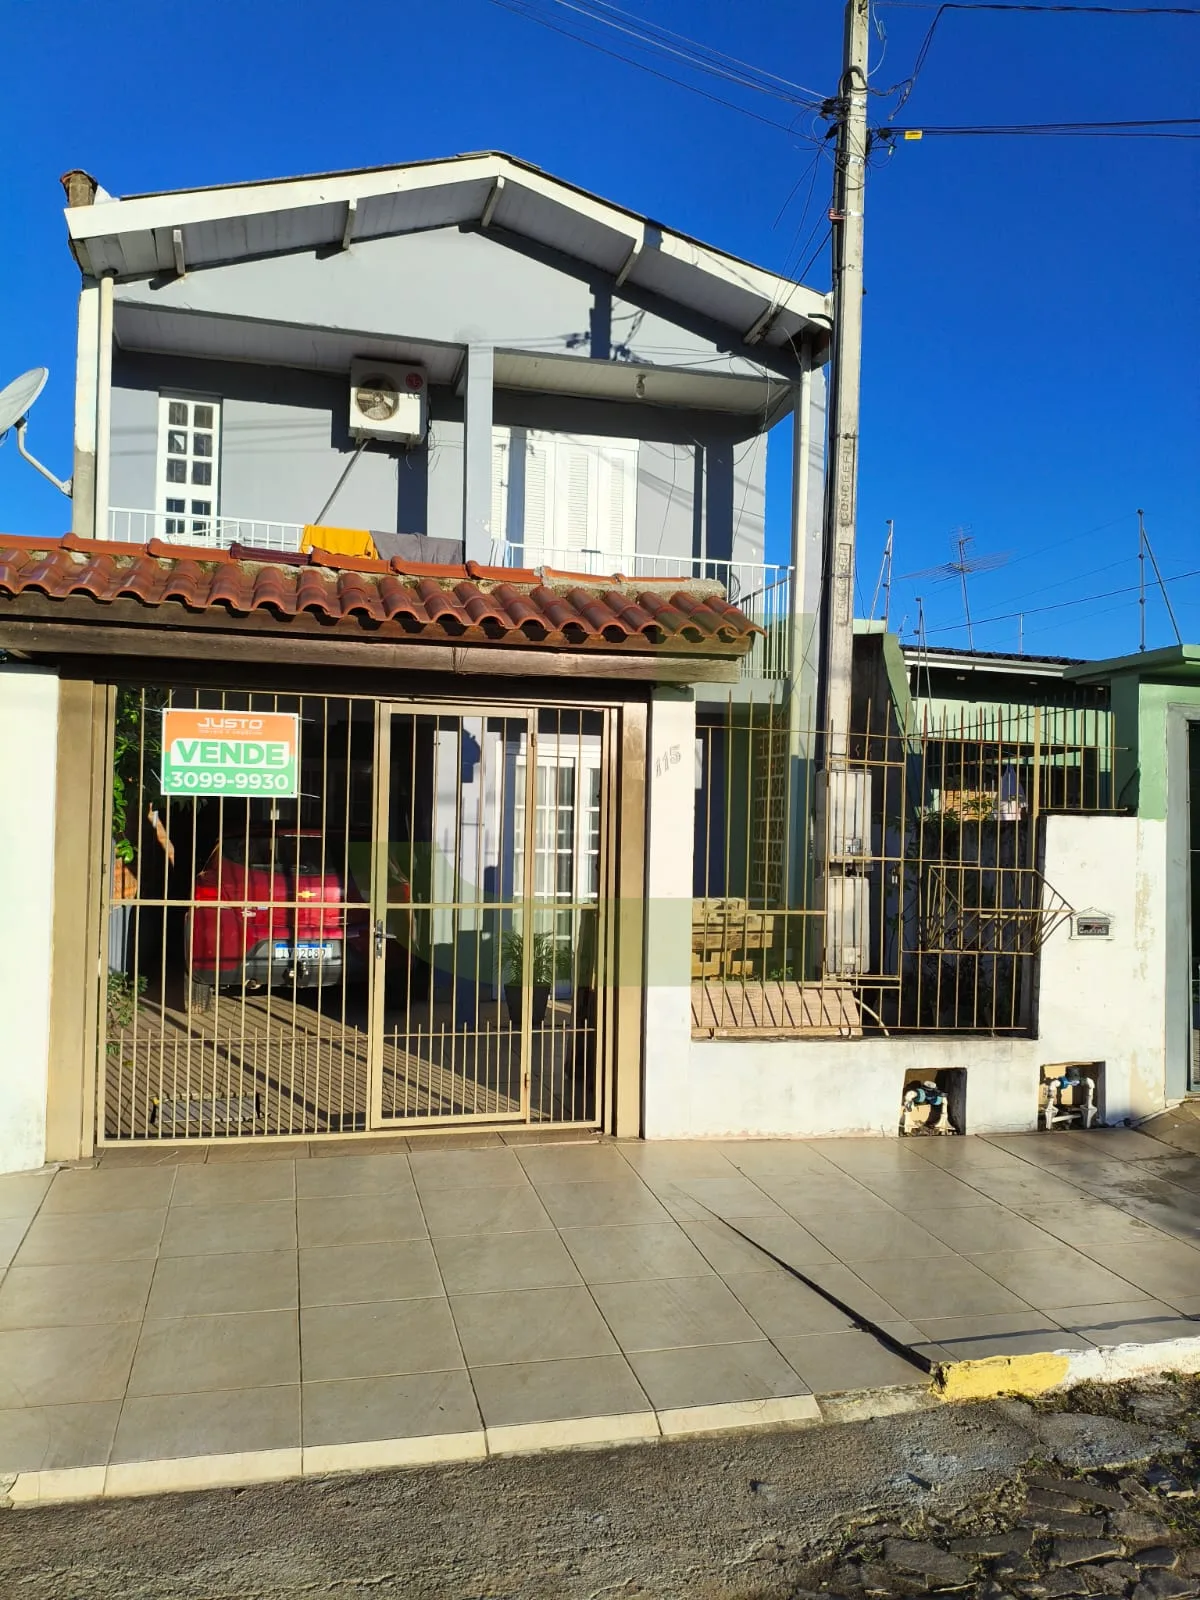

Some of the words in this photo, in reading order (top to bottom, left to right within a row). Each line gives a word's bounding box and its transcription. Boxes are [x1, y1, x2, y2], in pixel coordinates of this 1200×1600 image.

[407, 391, 421, 400] LG
[197, 717, 264, 730] JUSTO
[176, 740, 285, 765] VENDE
[656, 744, 681, 777] 115
[170, 771, 289, 790] 3099-9930
